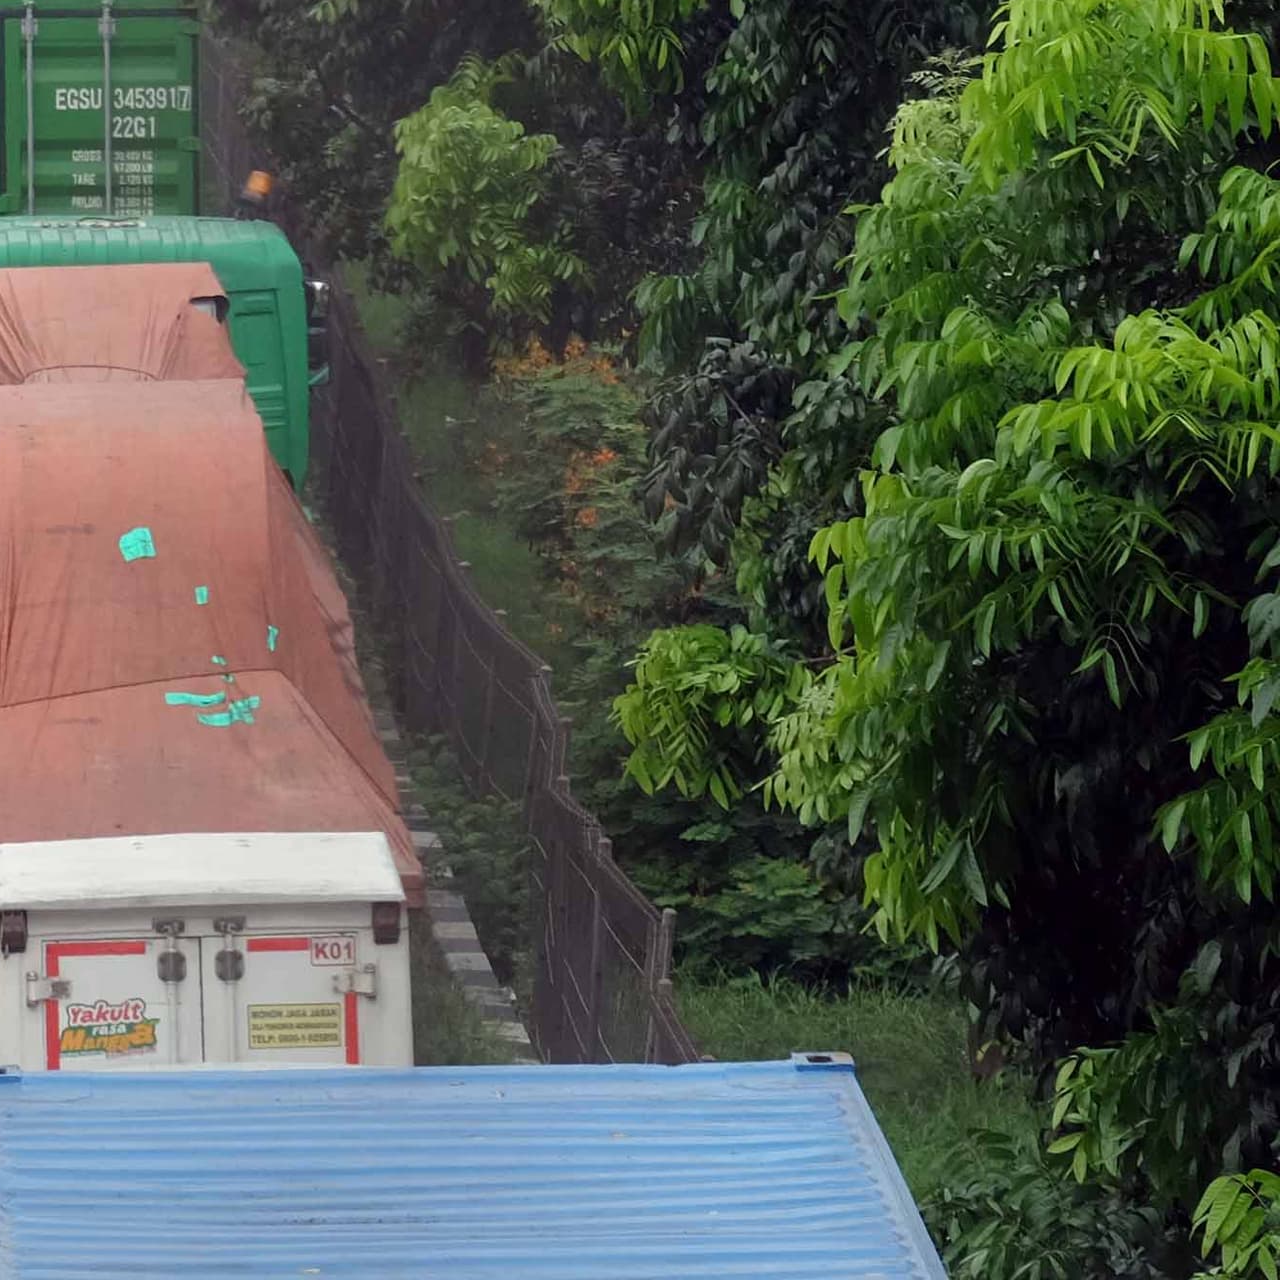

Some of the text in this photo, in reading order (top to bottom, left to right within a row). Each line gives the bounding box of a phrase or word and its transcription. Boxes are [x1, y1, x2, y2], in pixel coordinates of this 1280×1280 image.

[55, 86, 192, 111] EGSU 3453917
[112, 116, 156, 139] 22G1
[314, 941, 353, 960] K01
[69, 1000, 142, 1024] Yakult
